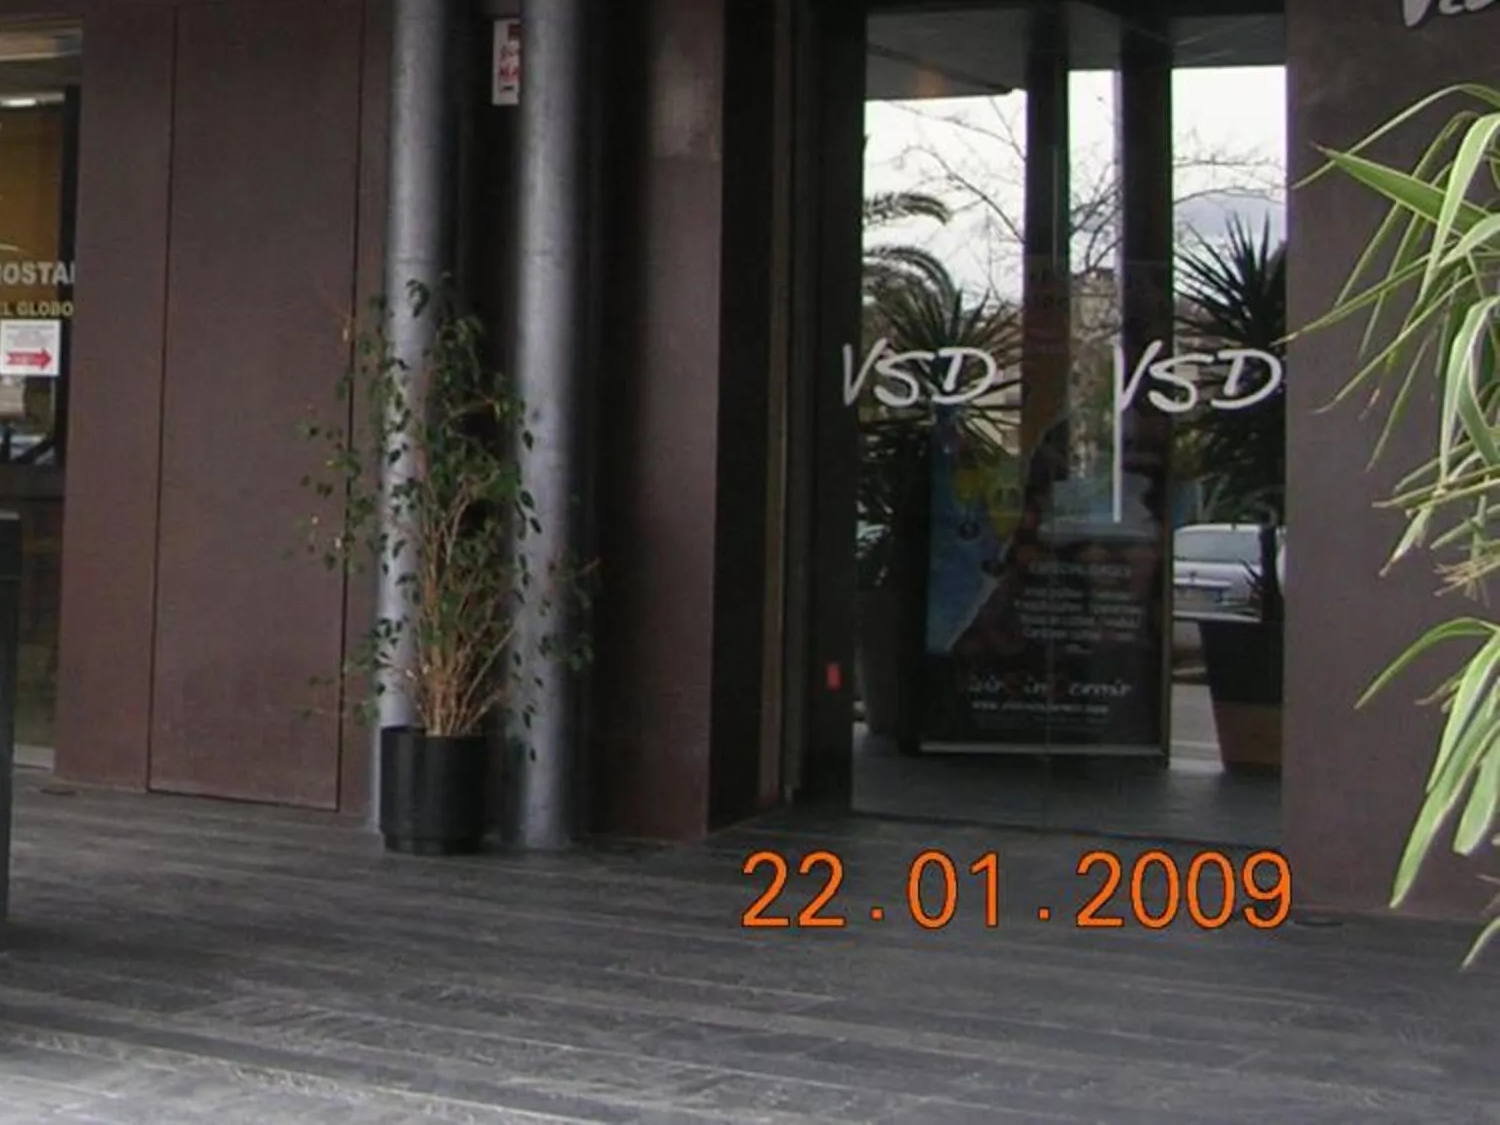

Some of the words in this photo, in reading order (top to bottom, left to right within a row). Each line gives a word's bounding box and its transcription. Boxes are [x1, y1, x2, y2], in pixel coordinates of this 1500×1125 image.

[16, 301, 75, 317] GLOBO
[842, 336, 998, 408] VSD
[1112, 339, 1283, 414] VSD
